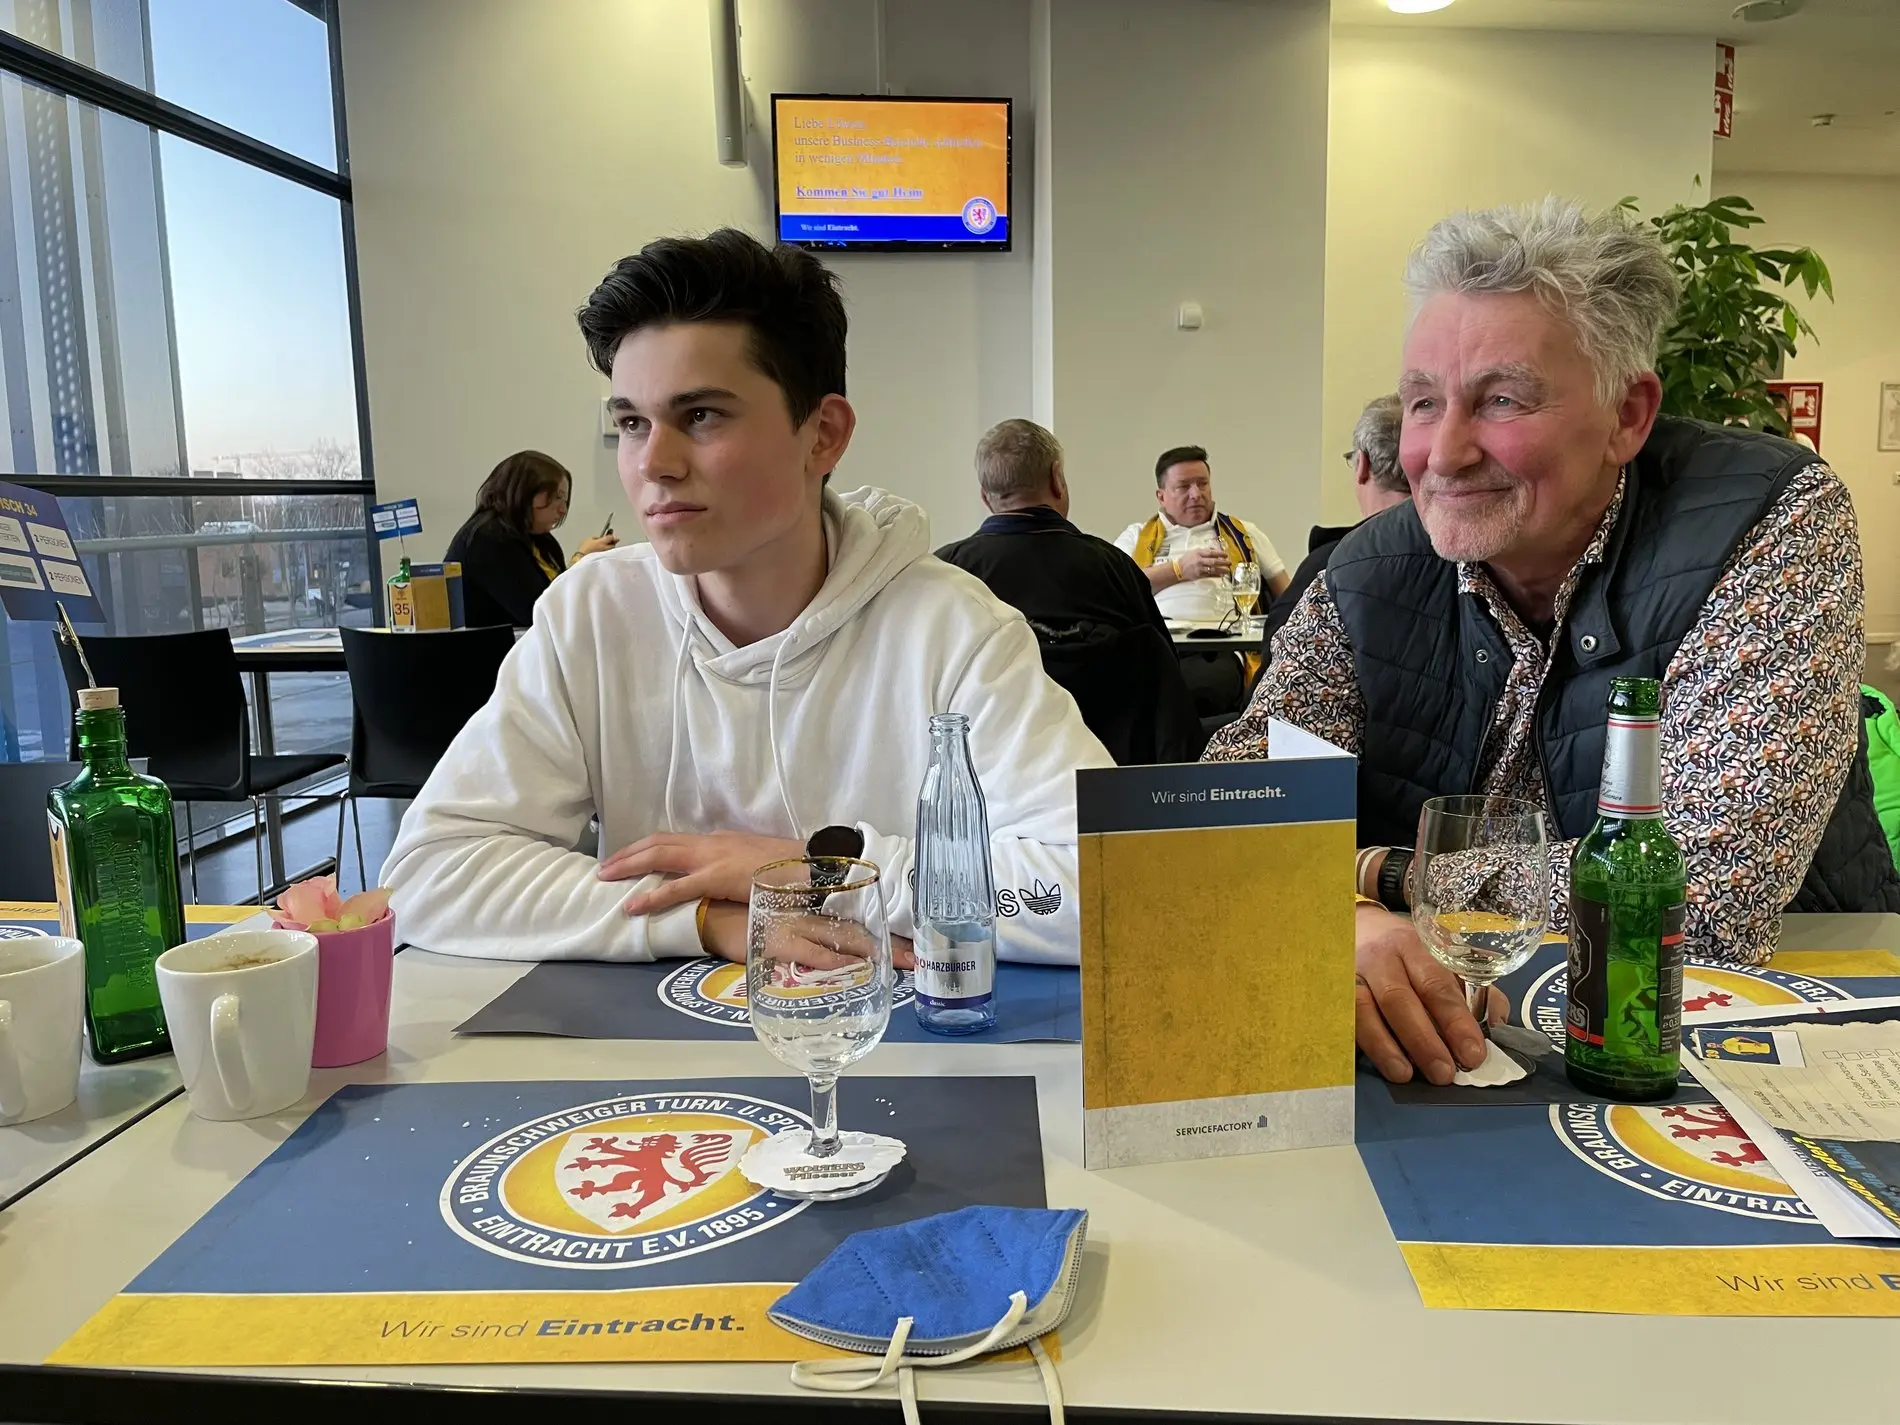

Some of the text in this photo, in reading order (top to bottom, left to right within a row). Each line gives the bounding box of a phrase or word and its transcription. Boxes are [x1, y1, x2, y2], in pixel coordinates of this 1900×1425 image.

[794, 116, 824, 129] Liebe
[794, 136, 829, 146] unsere
[795, 151, 805, 163] in
[809, 153, 853, 166] wenigen
[797, 186, 848, 197] Kommen
[852, 187, 867, 197] Sie
[24, 503, 38, 517] 34
[39, 534, 69, 549] PERSONEN
[54, 572, 84, 585] PERSONEN
[394, 603, 410, 616] 35
[1151, 786, 1286, 804] Wir sind Eintracht.
[926, 960, 976, 973] HARZBURGER
[1175, 1121, 1253, 1137] SERVICEFACTORY
[459, 1100, 647, 1204] BRAUNSCHWEIGER
[655, 1098, 734, 1111] TURN-
[737, 1105, 755, 1118] U.
[783, 1162, 866, 1174] WOLTERS
[785, 1170, 858, 1181] Pilsener
[472, 1207, 766, 1260] EINTRACHT E.V. 1895
[1716, 1275, 1785, 1292] Wir
[1796, 1273, 1877, 1290] sind
[380, 1312, 746, 1339] Wir sind Eintracht.
